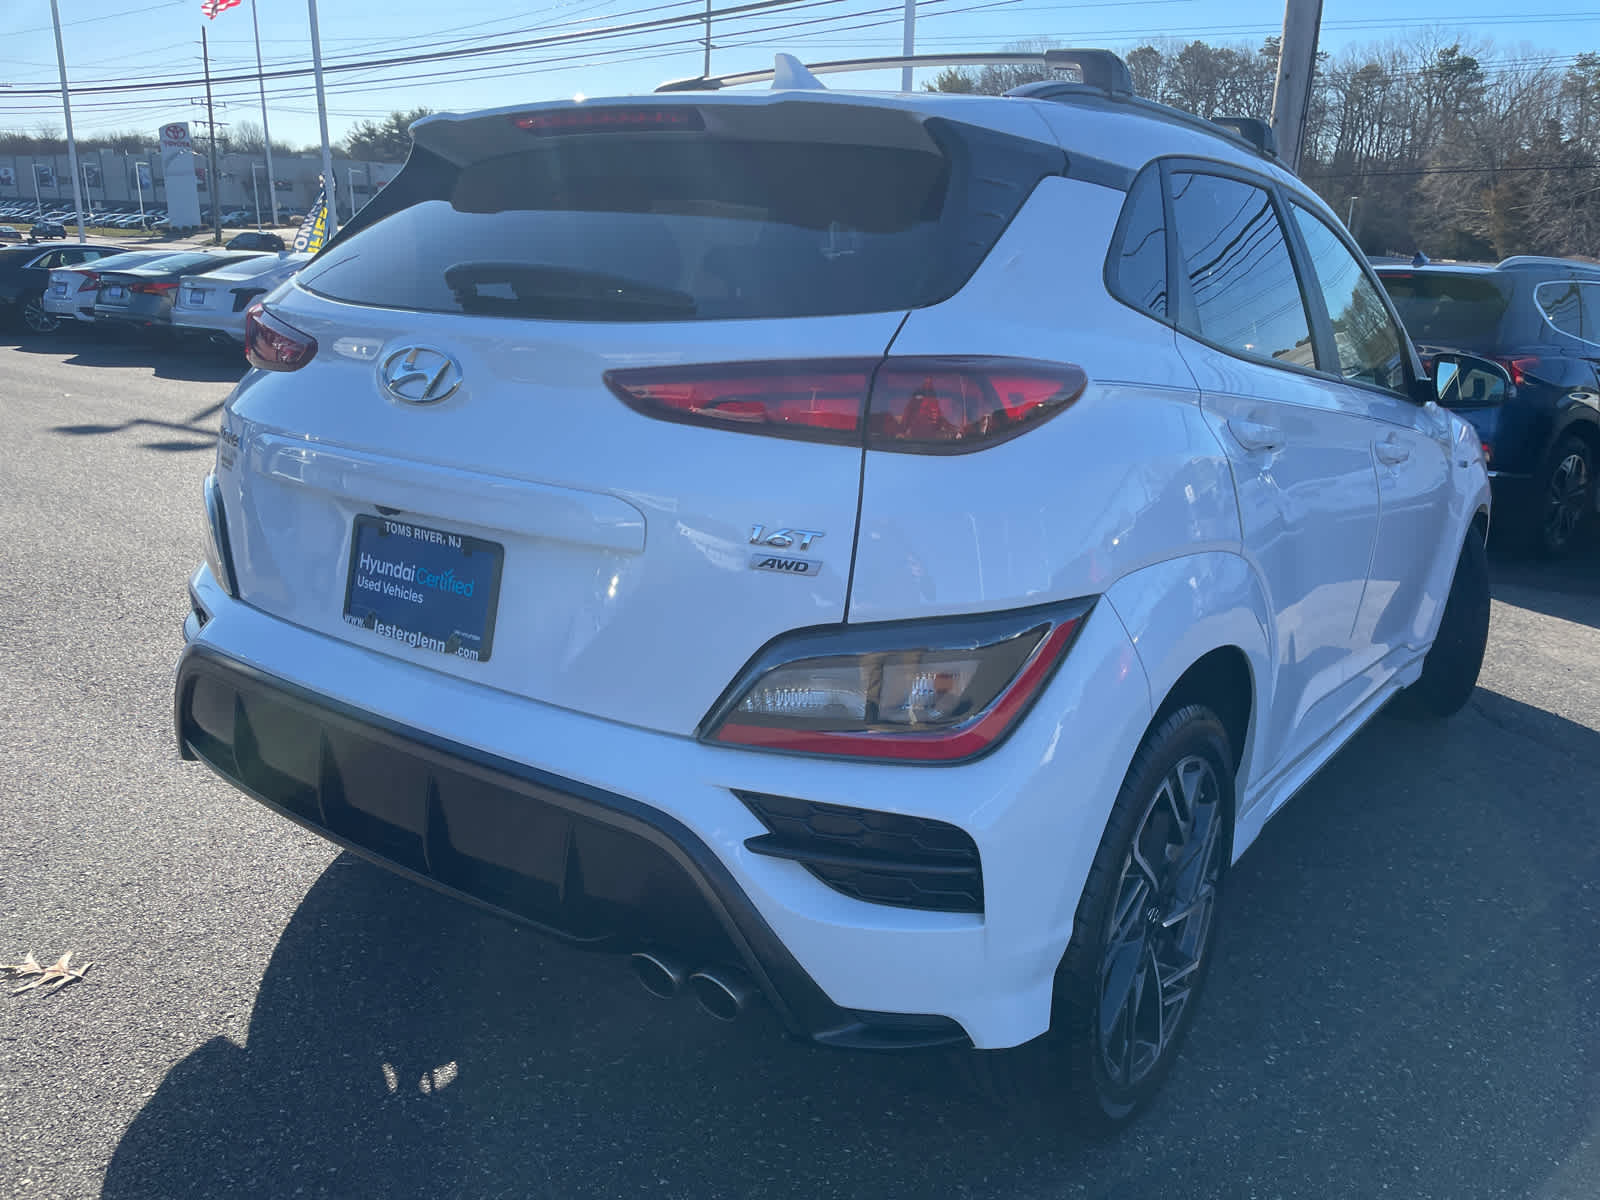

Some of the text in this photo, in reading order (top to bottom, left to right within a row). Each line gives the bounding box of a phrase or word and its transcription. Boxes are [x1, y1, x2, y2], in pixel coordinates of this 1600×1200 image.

[384, 521, 412, 537] TOMS
[448, 535, 462, 548] NJ
[359, 552, 475, 597] Hyundai Certified
[758, 558, 809, 572] AWD
[357, 576, 424, 604] Used Vehicles
